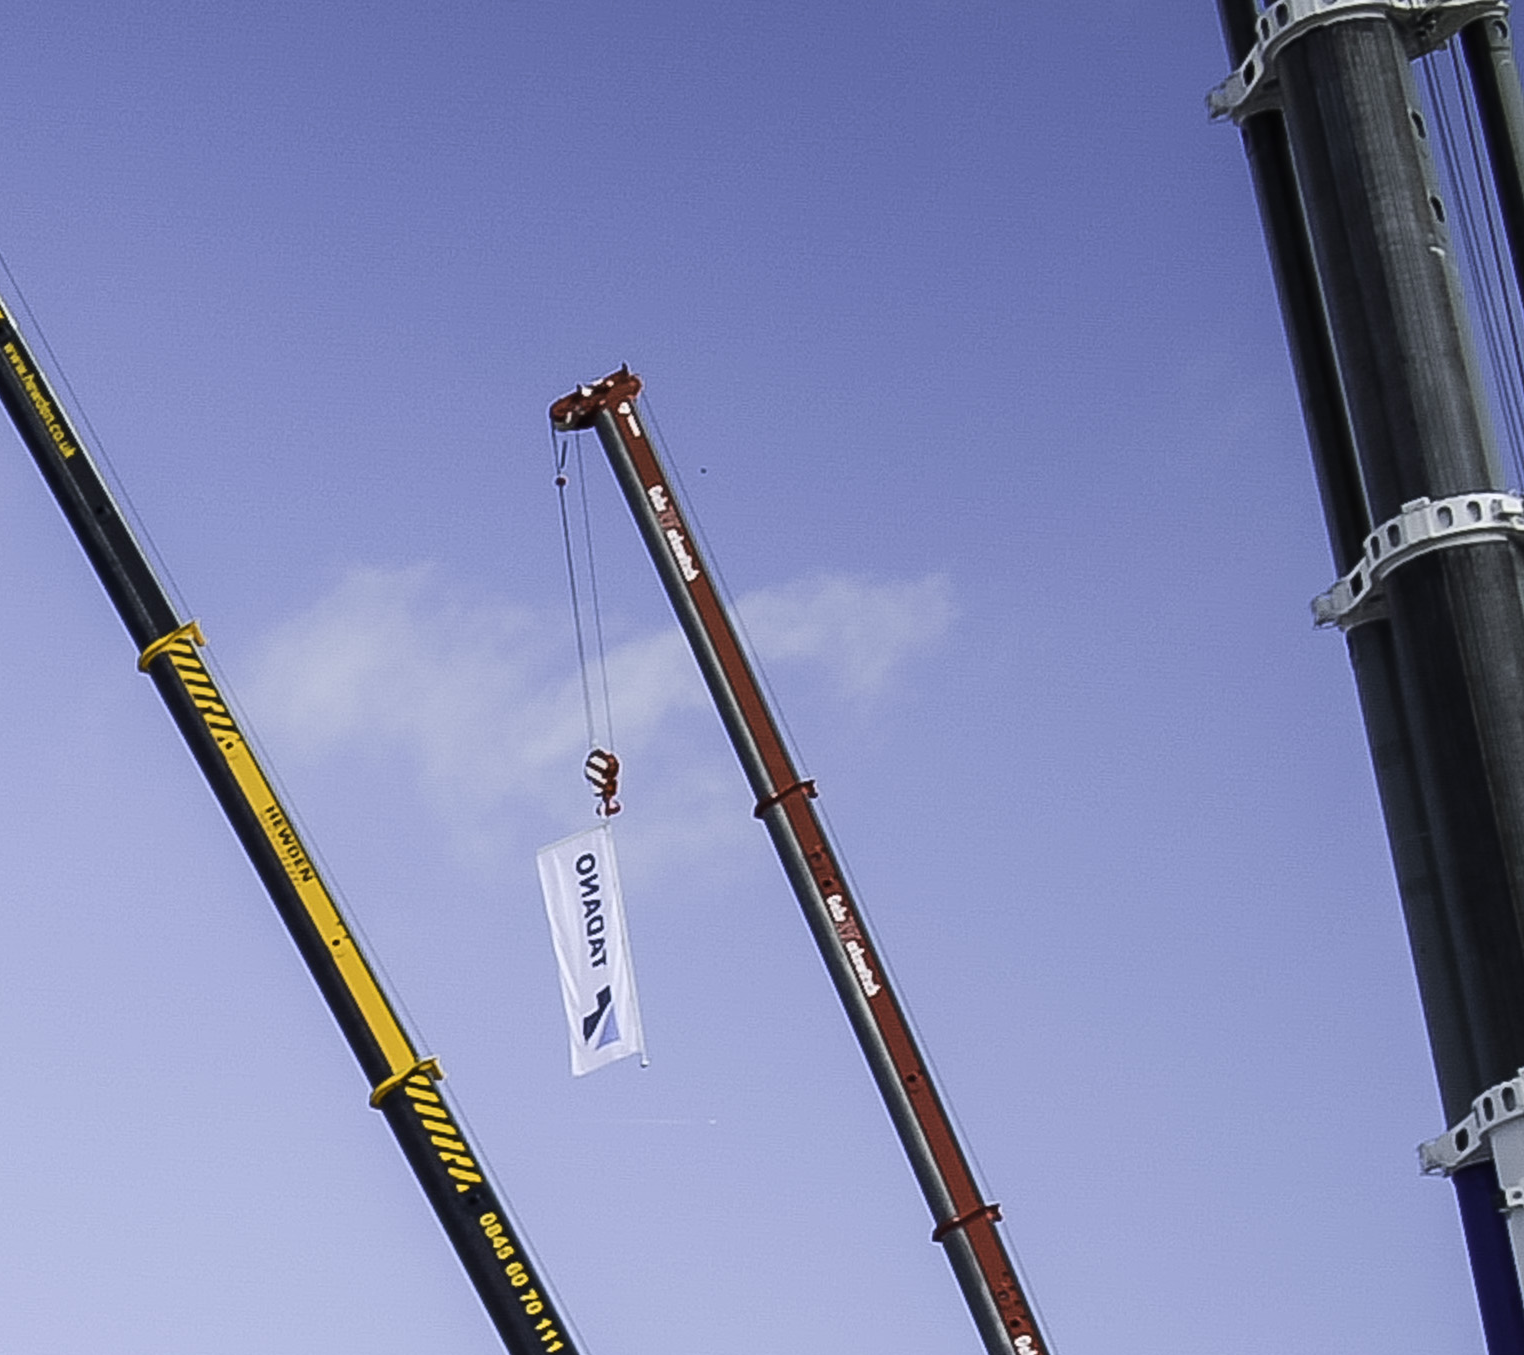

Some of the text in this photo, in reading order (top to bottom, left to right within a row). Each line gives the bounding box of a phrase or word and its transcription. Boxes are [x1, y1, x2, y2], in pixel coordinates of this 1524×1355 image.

[266, 805, 314, 882] HEWDEN
[519, 1288, 544, 1315] 70
[535, 1318, 564, 1353] 111
